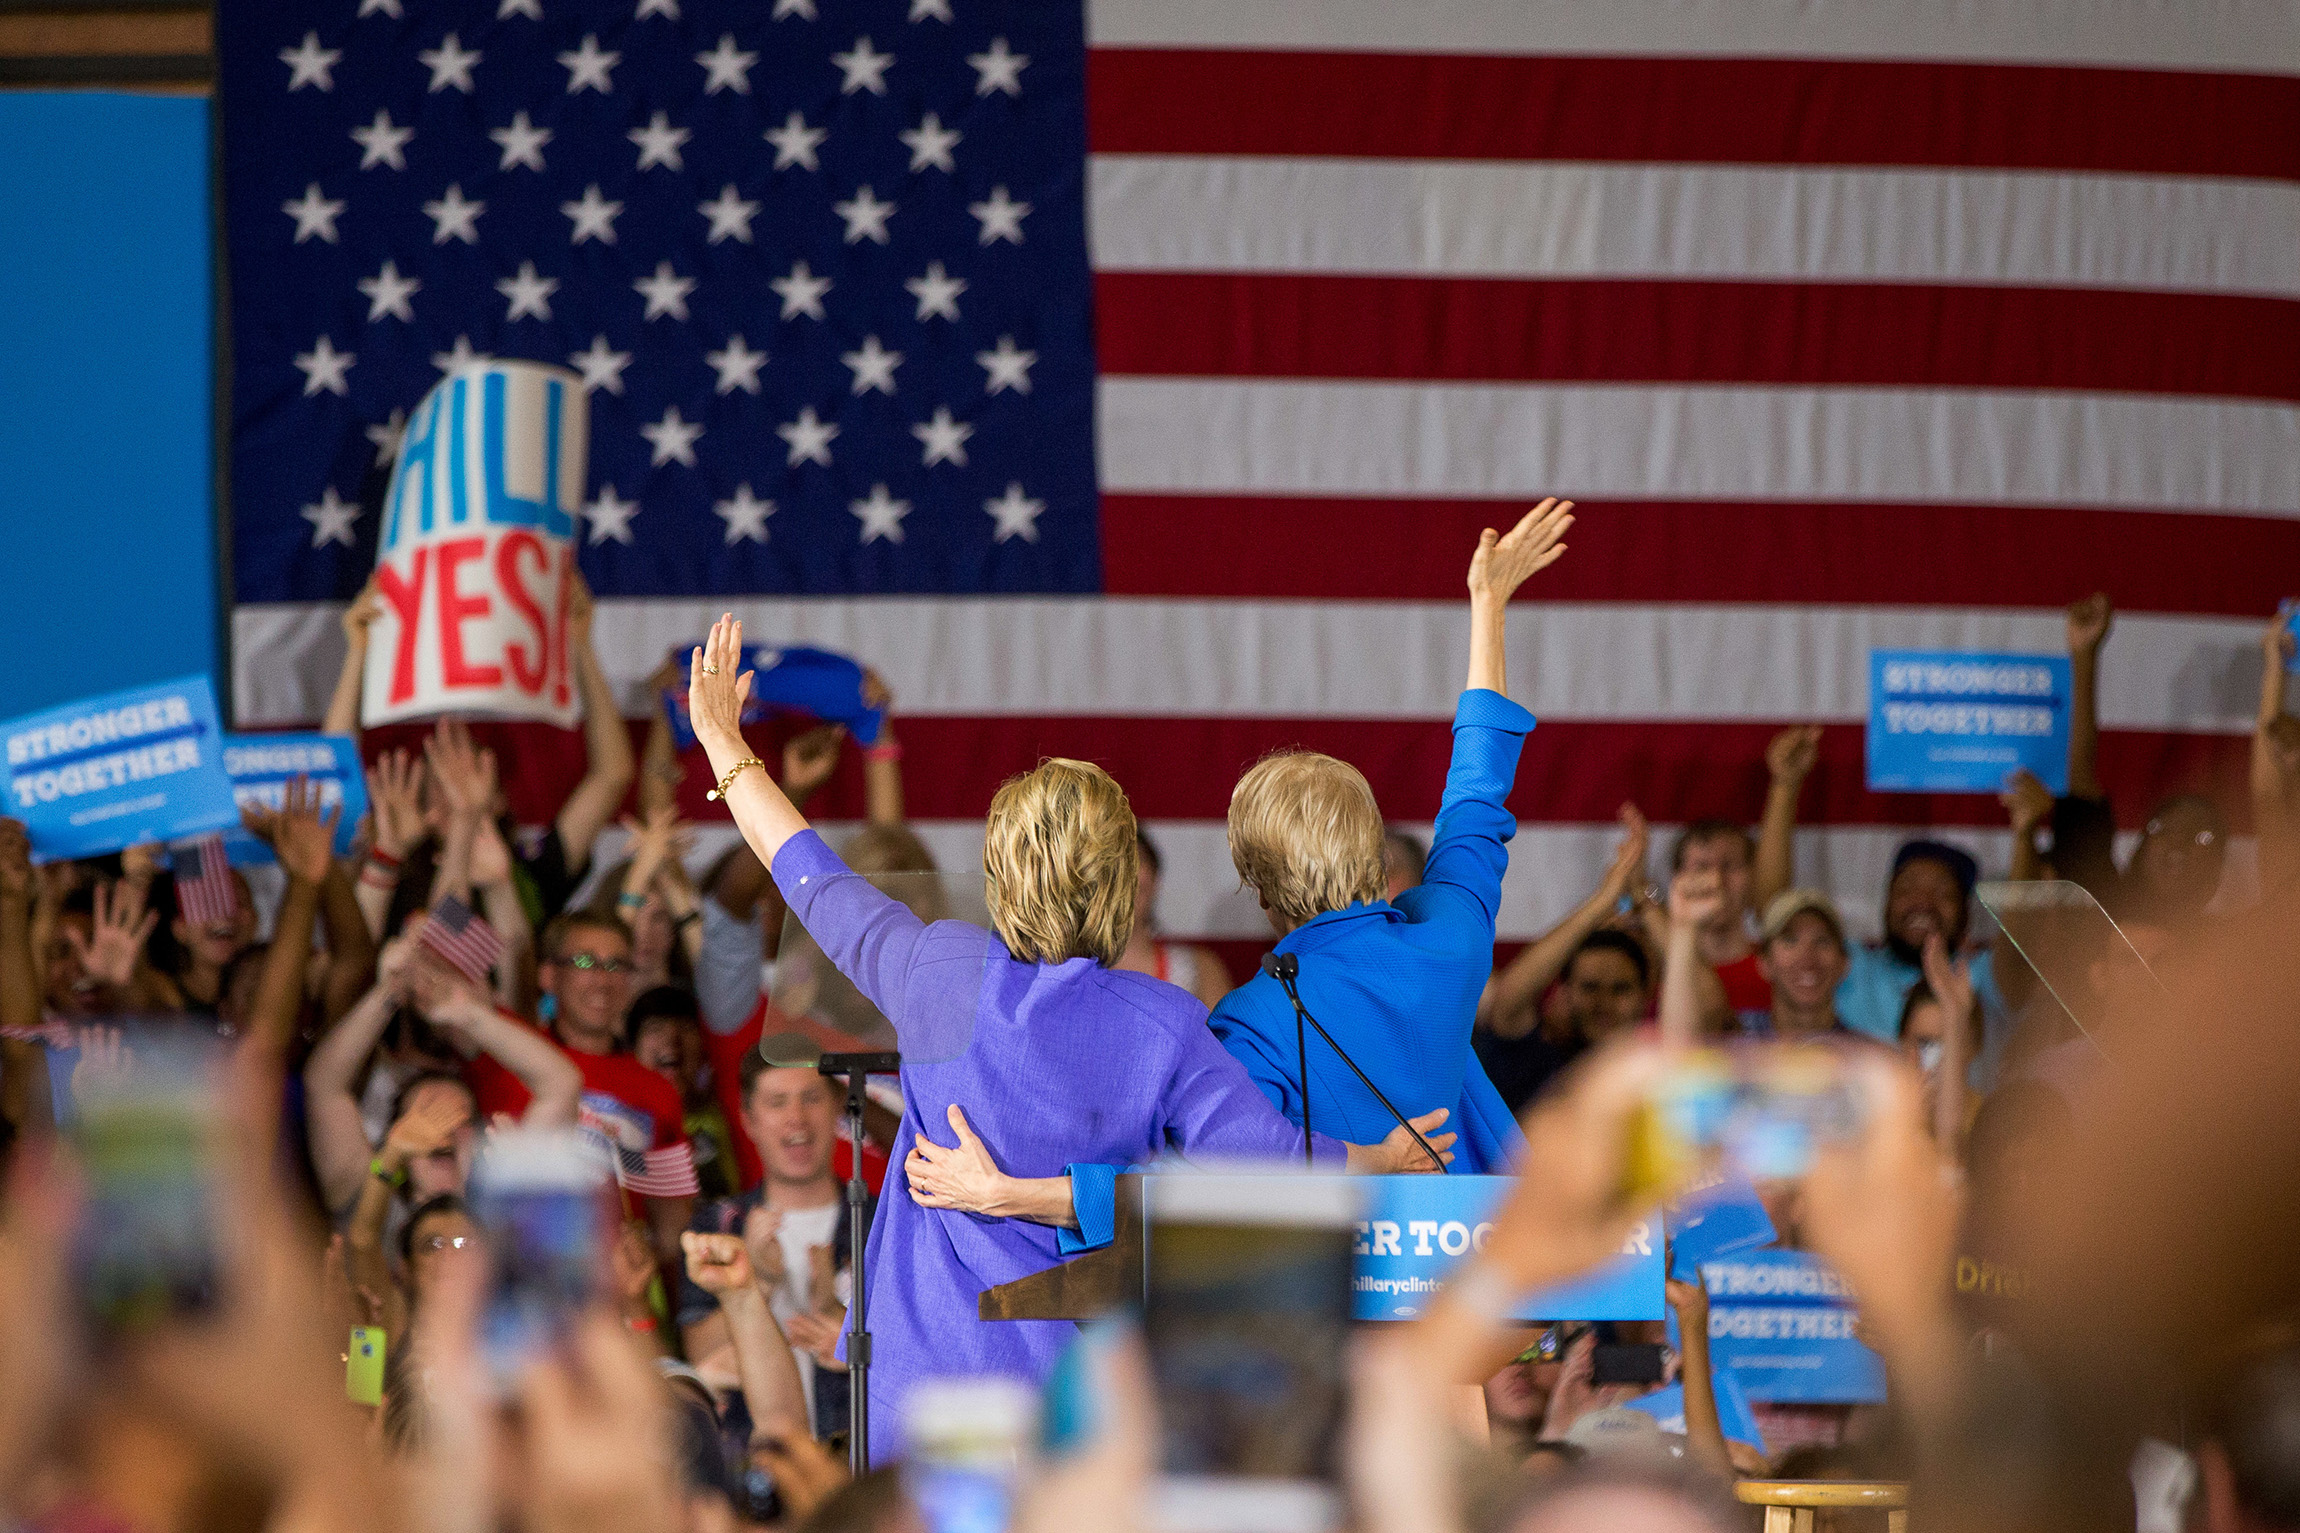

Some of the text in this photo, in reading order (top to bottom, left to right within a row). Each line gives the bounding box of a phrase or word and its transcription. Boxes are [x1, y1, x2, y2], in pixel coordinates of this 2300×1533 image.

[386, 371, 574, 549] HILL
[377, 530, 574, 706] YES!
[7, 696, 191, 764] STRONGER
[1884, 702, 2053, 736] TOGETHER
[12, 737, 200, 807] TOGETHER
